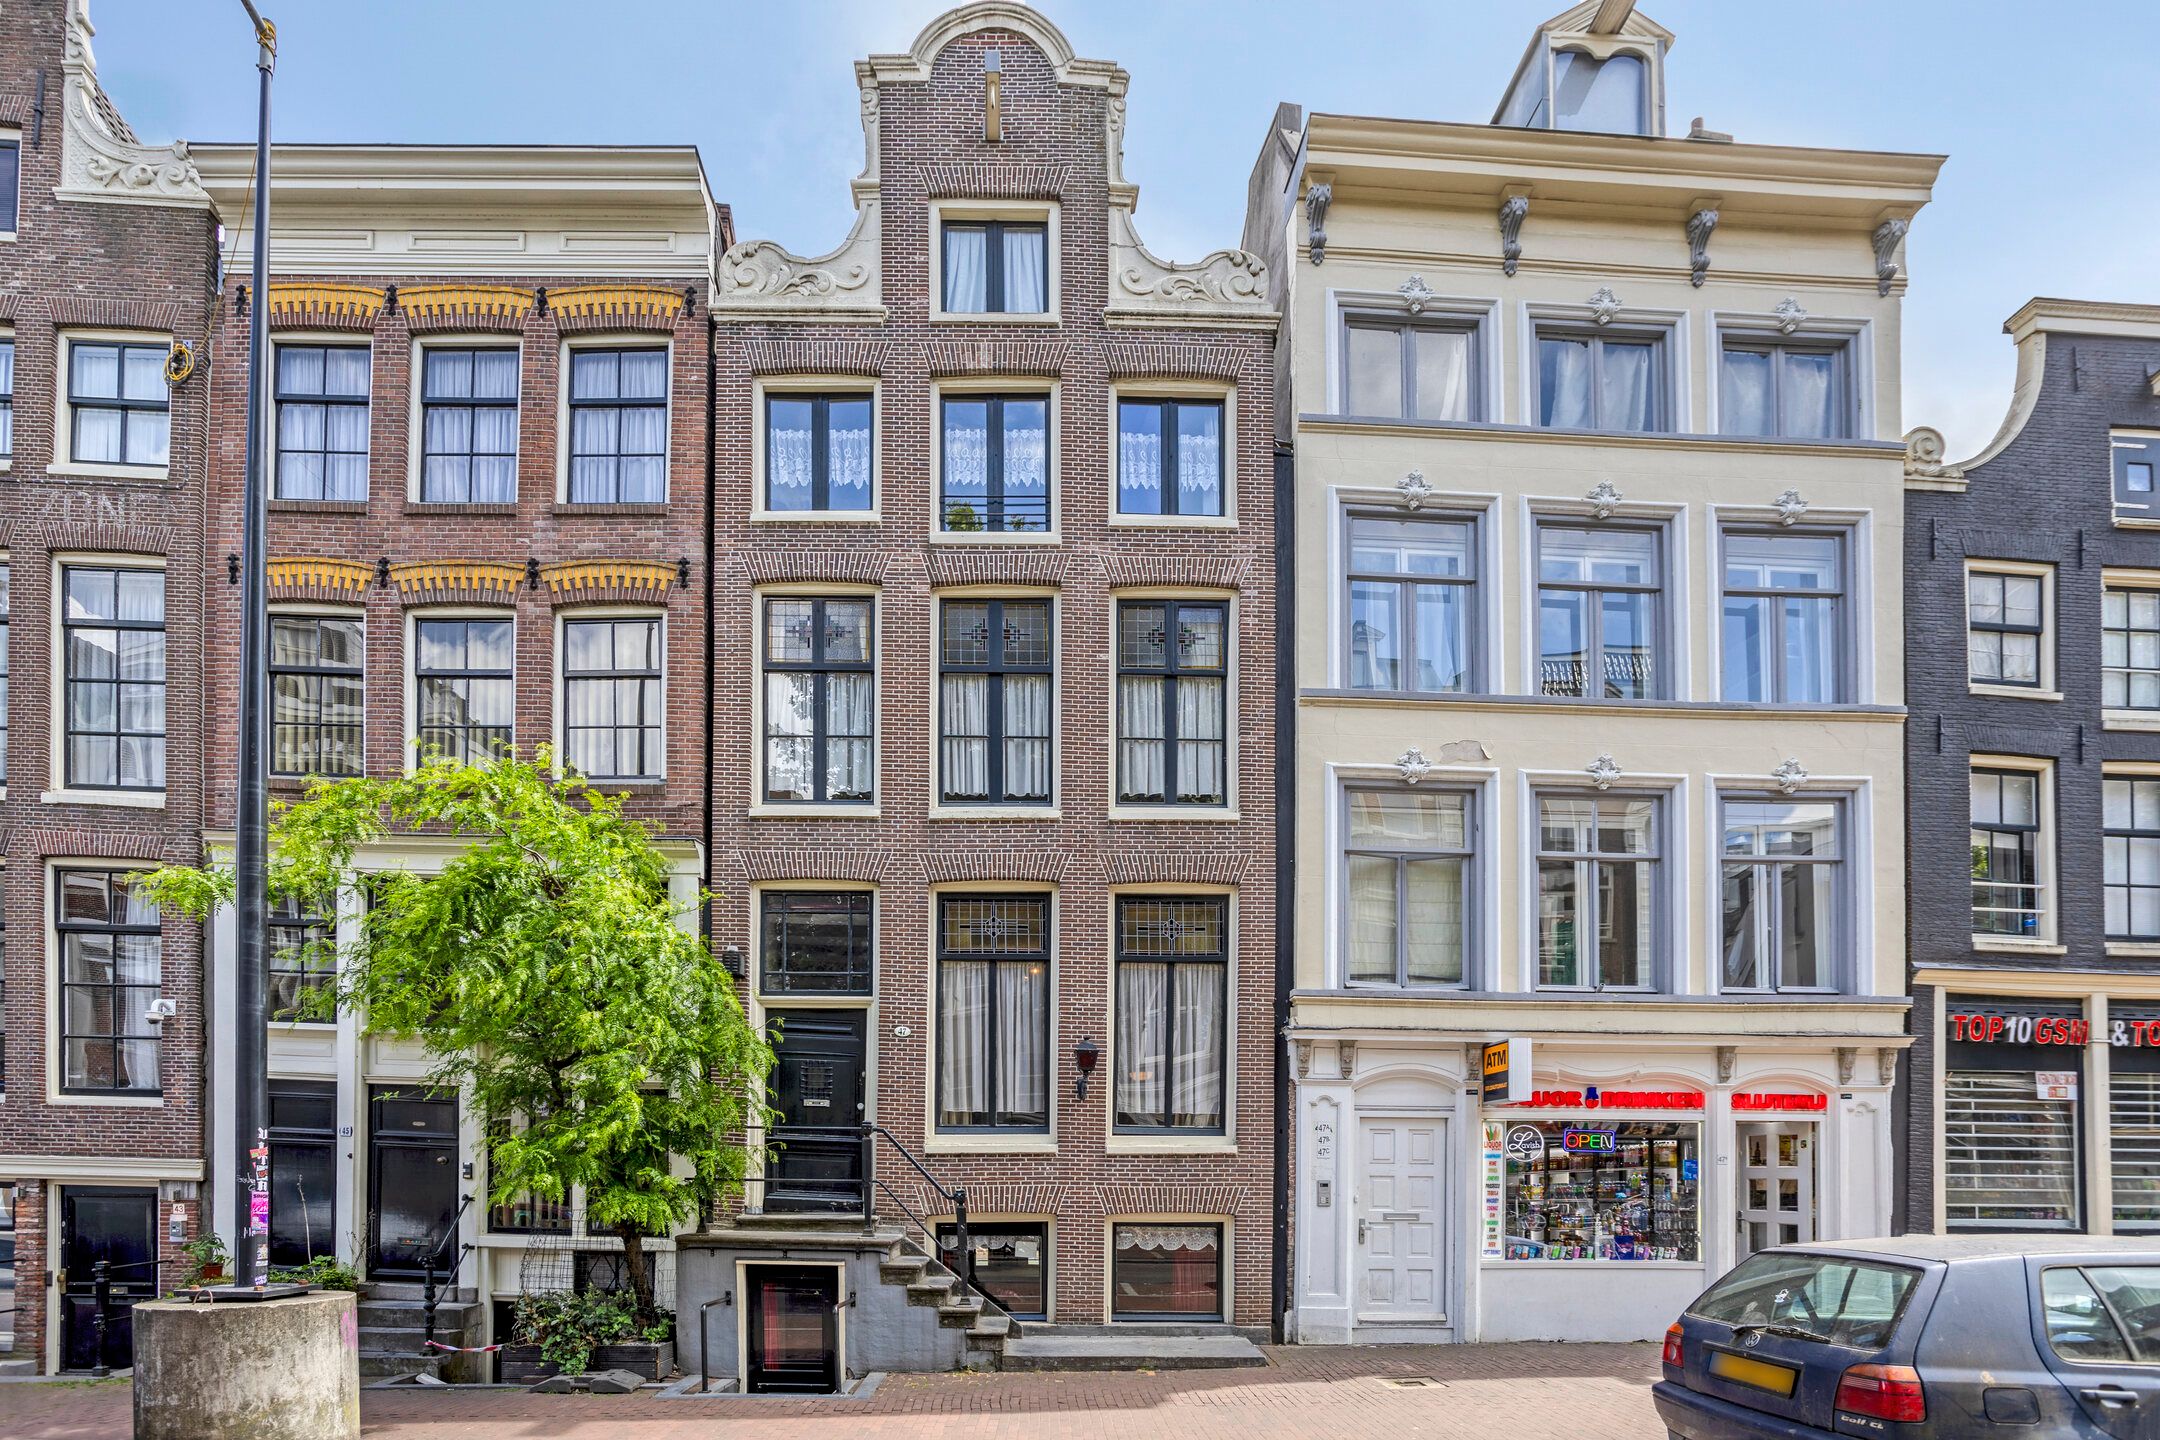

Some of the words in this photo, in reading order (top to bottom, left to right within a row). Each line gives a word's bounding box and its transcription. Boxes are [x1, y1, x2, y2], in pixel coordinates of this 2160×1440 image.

[898, 1028, 906, 1036] 47
[2112, 1020, 2129, 1047] &
[1486, 1049, 1507, 1069] ATM
[342, 1126, 350, 1134] 45
[1509, 1131, 1541, 1153] Lavish
[1566, 1133, 1613, 1149] OPEN
[1840, 1414, 1867, 1426] Golf
